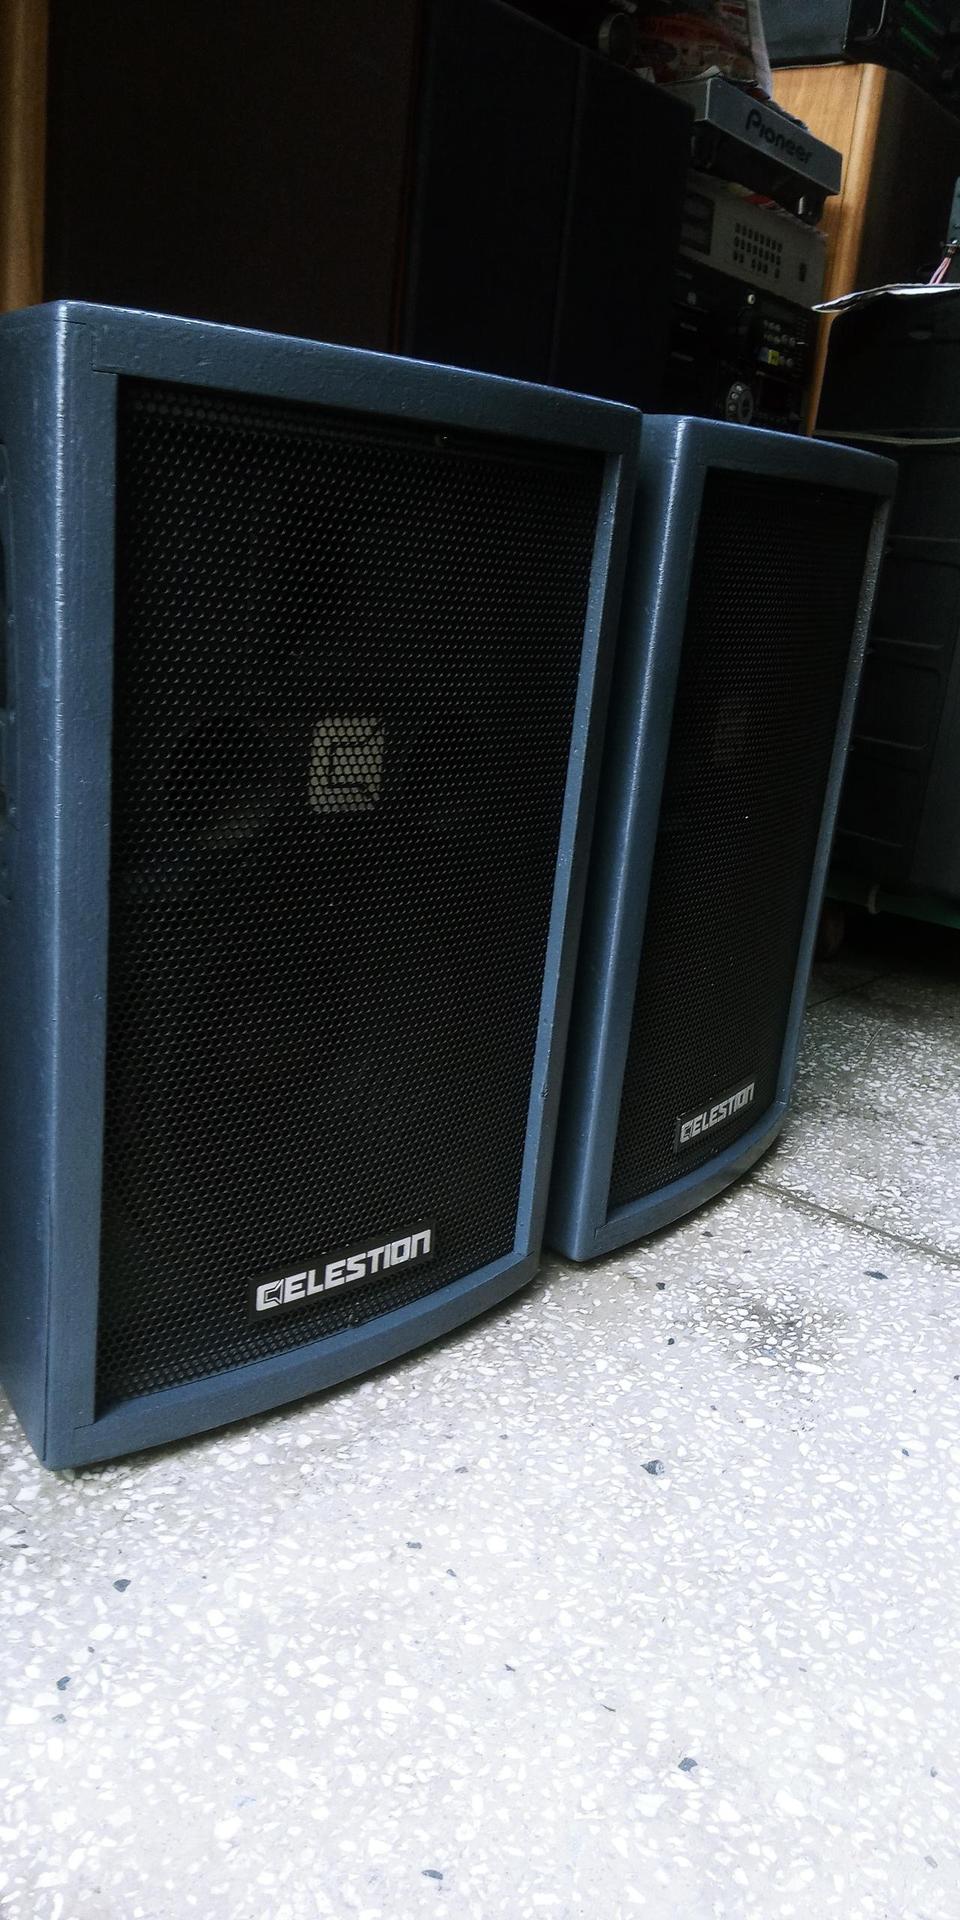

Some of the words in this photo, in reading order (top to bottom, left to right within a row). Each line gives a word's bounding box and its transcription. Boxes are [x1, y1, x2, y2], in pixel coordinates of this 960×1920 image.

[746, 108, 812, 164] Pioneer
[680, 1082, 755, 1143] CELESTION
[256, 1230, 431, 1311] CELESTION
